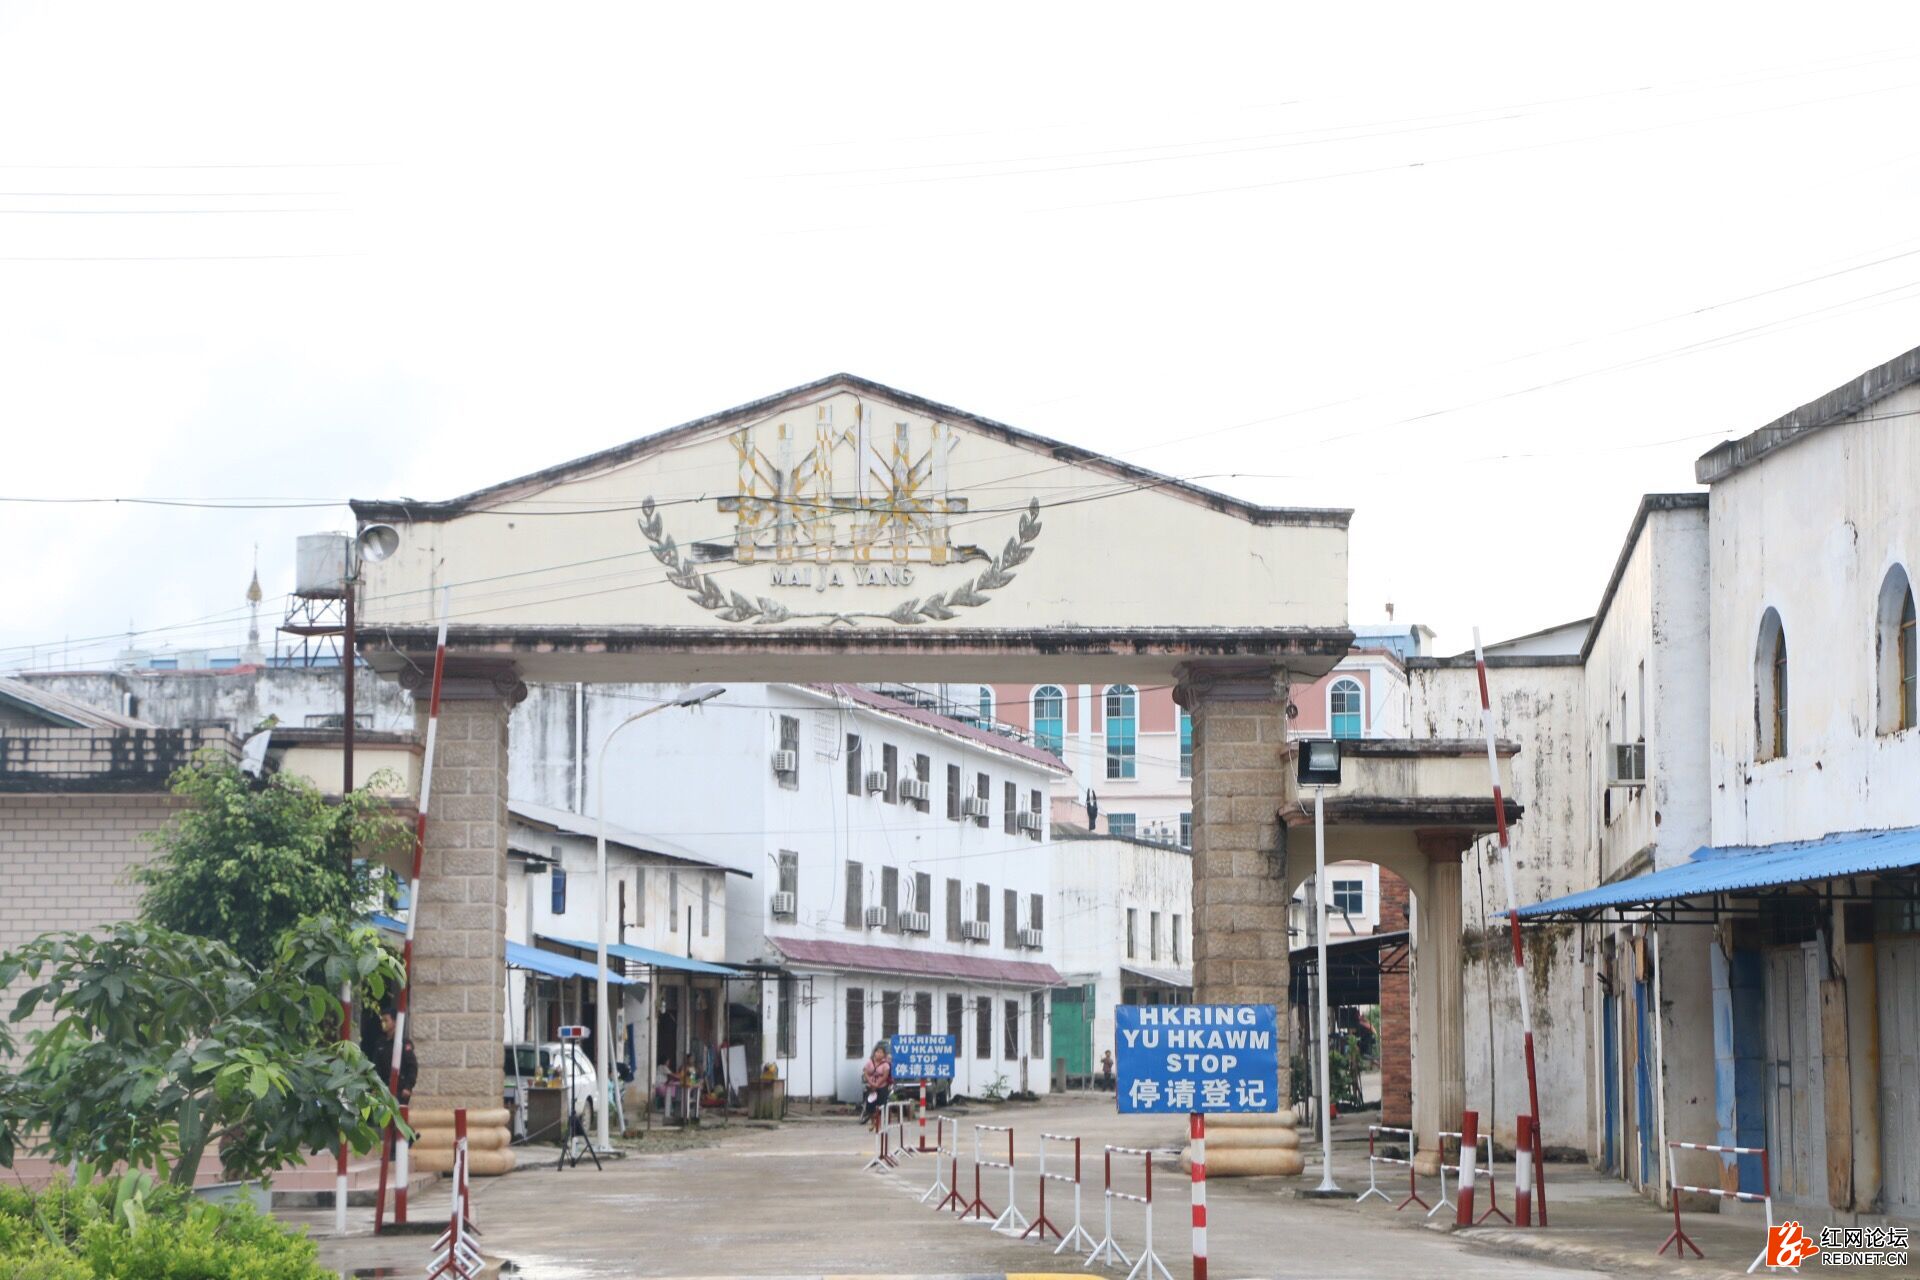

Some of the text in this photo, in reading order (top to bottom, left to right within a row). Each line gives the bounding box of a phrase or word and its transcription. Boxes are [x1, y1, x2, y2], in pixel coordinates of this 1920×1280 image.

[770, 567, 811, 586] MAI
[853, 567, 915, 587] YANG
[1140, 1007, 1256, 1026] HKRING
[900, 1036, 946, 1044] HKRING
[1123, 1030, 1269, 1050] YU HKAWM
[894, 1046, 952, 1054] YU HKAWM
[896, 1064, 950, 1076] 停请登记
[1167, 1054, 1237, 1073] STOP
[1129, 1078, 1267, 1108] 停请登记
